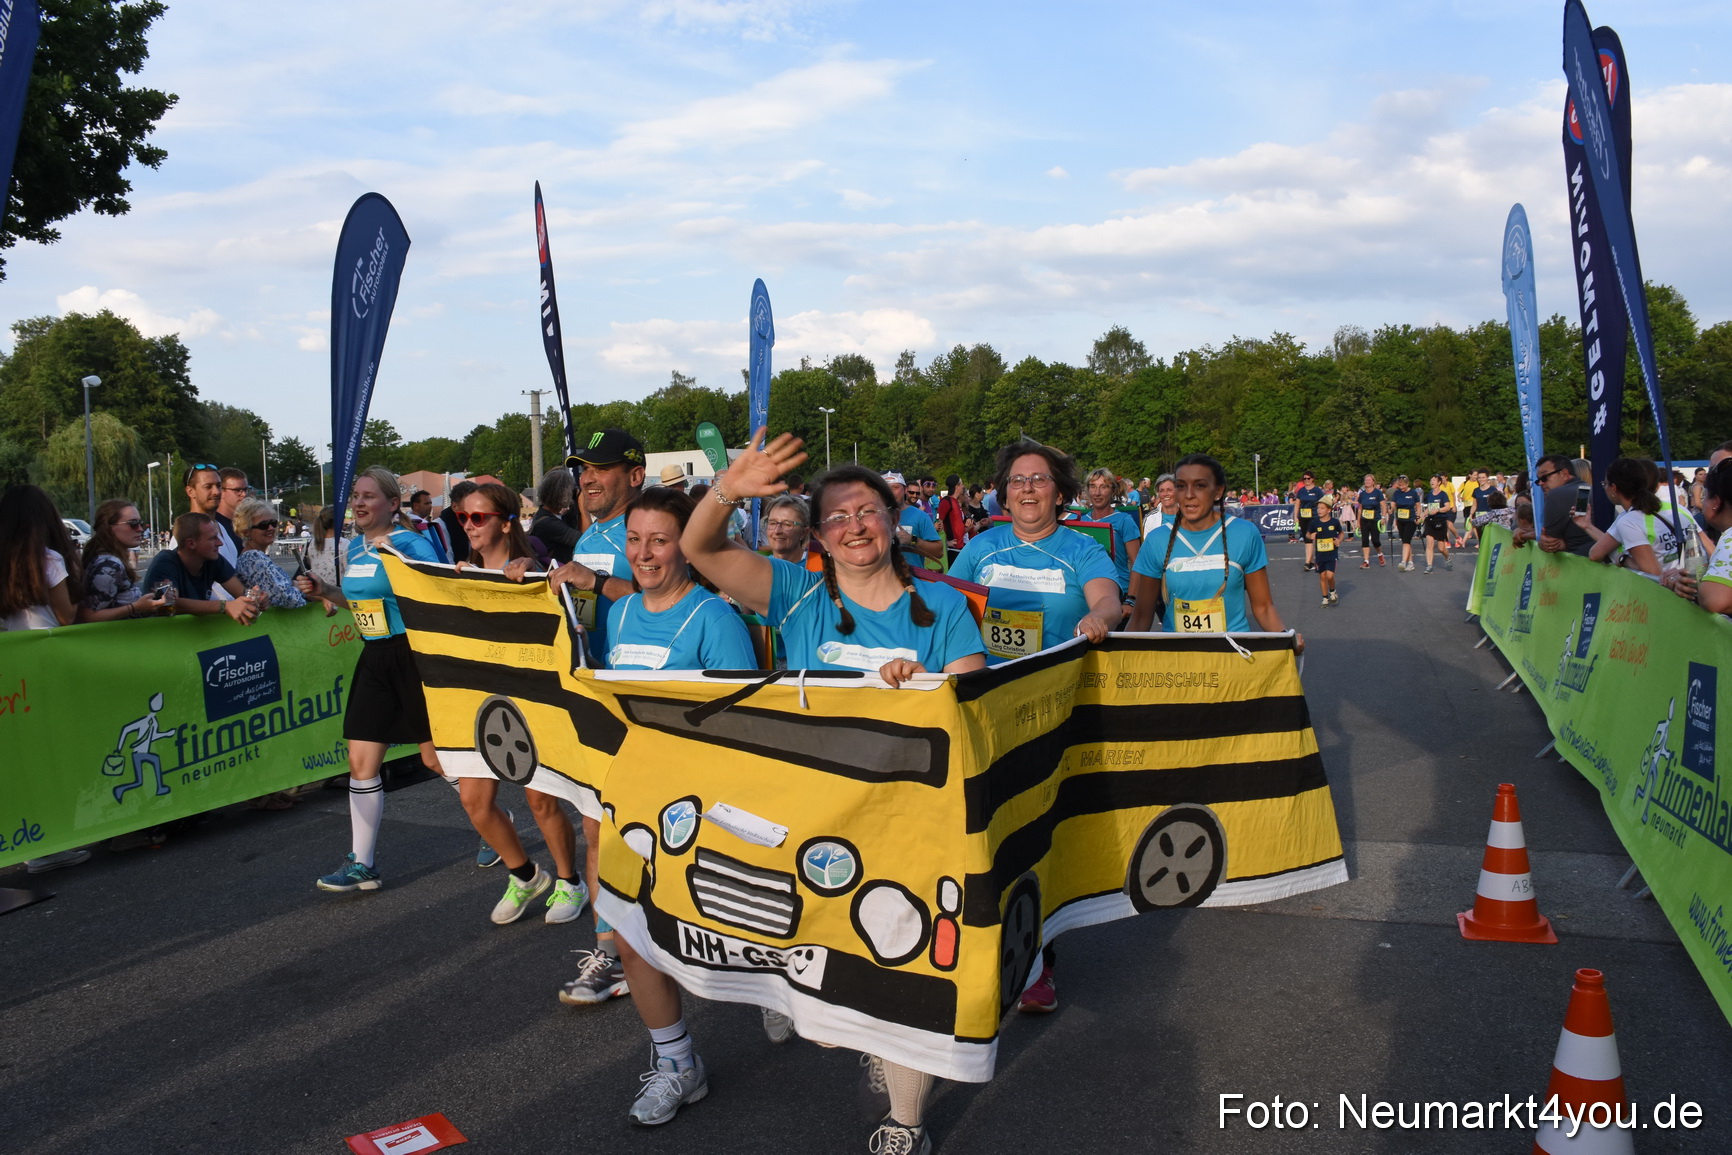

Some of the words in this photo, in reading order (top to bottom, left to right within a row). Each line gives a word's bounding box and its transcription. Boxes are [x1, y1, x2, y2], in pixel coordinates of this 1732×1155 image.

[359, 226, 385, 305] Fischer
[370, 242, 389, 304] AUTOMOBILE
[1270, 517, 1296, 527] Fisc
[356, 613, 375, 627] 831
[1183, 614, 1212, 630] 841
[991, 625, 1026, 647] 833
[518, 647, 555, 666] HAUS
[218, 660, 268, 683] Fischer
[223, 671, 265, 689] AUTOMOBILE
[1115, 672, 1219, 689] GRUNDSCHULE
[1691, 696, 1712, 720] Fischer
[174, 675, 344, 770] firmenlauf
[181, 745, 261, 786] neumarkt
[1080, 749, 1145, 768] MARIEN
[1650, 811, 1688, 850] neumarkt
[683, 926, 789, 967] NM-GS
